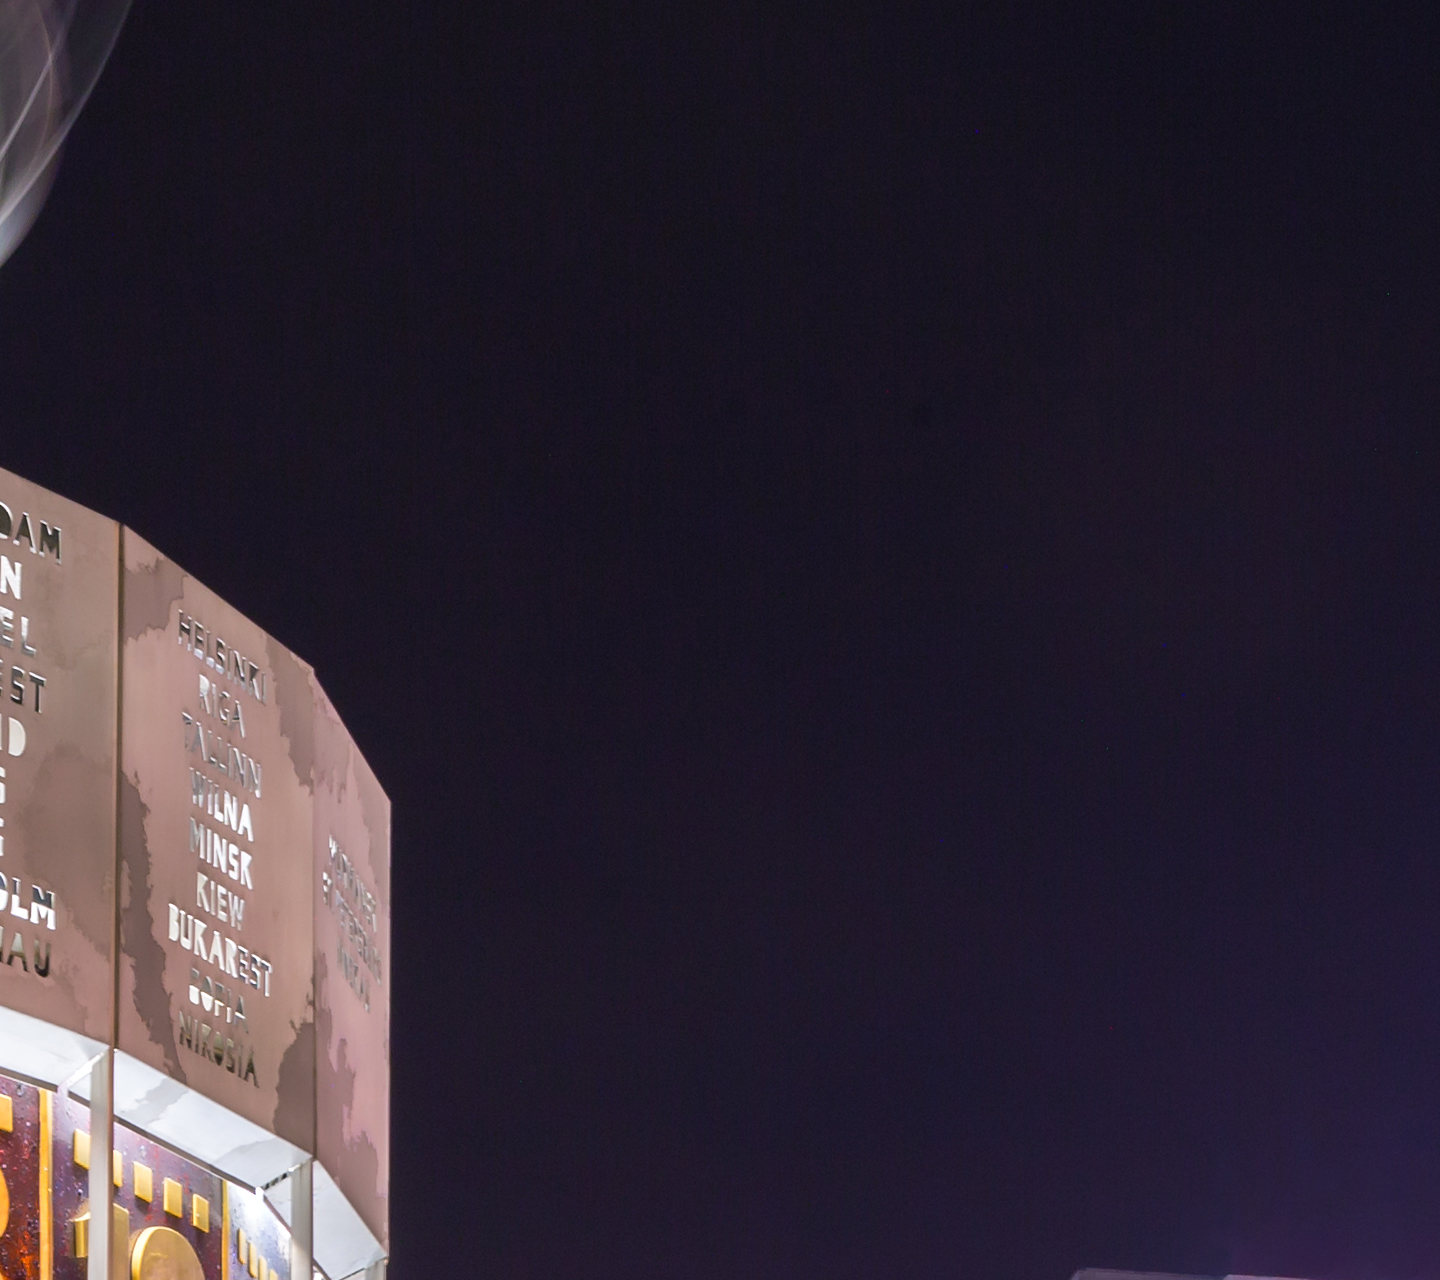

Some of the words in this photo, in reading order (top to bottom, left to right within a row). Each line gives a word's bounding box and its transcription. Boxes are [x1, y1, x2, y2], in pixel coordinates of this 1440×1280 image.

[176, 607, 267, 706] HELSINKI
[197, 673, 246, 739] RIGA
[188, 766, 255, 843] WILNA
[188, 816, 254, 890] MINSK
[196, 871, 246, 932] KIEW
[167, 902, 273, 998] BUKAREST
